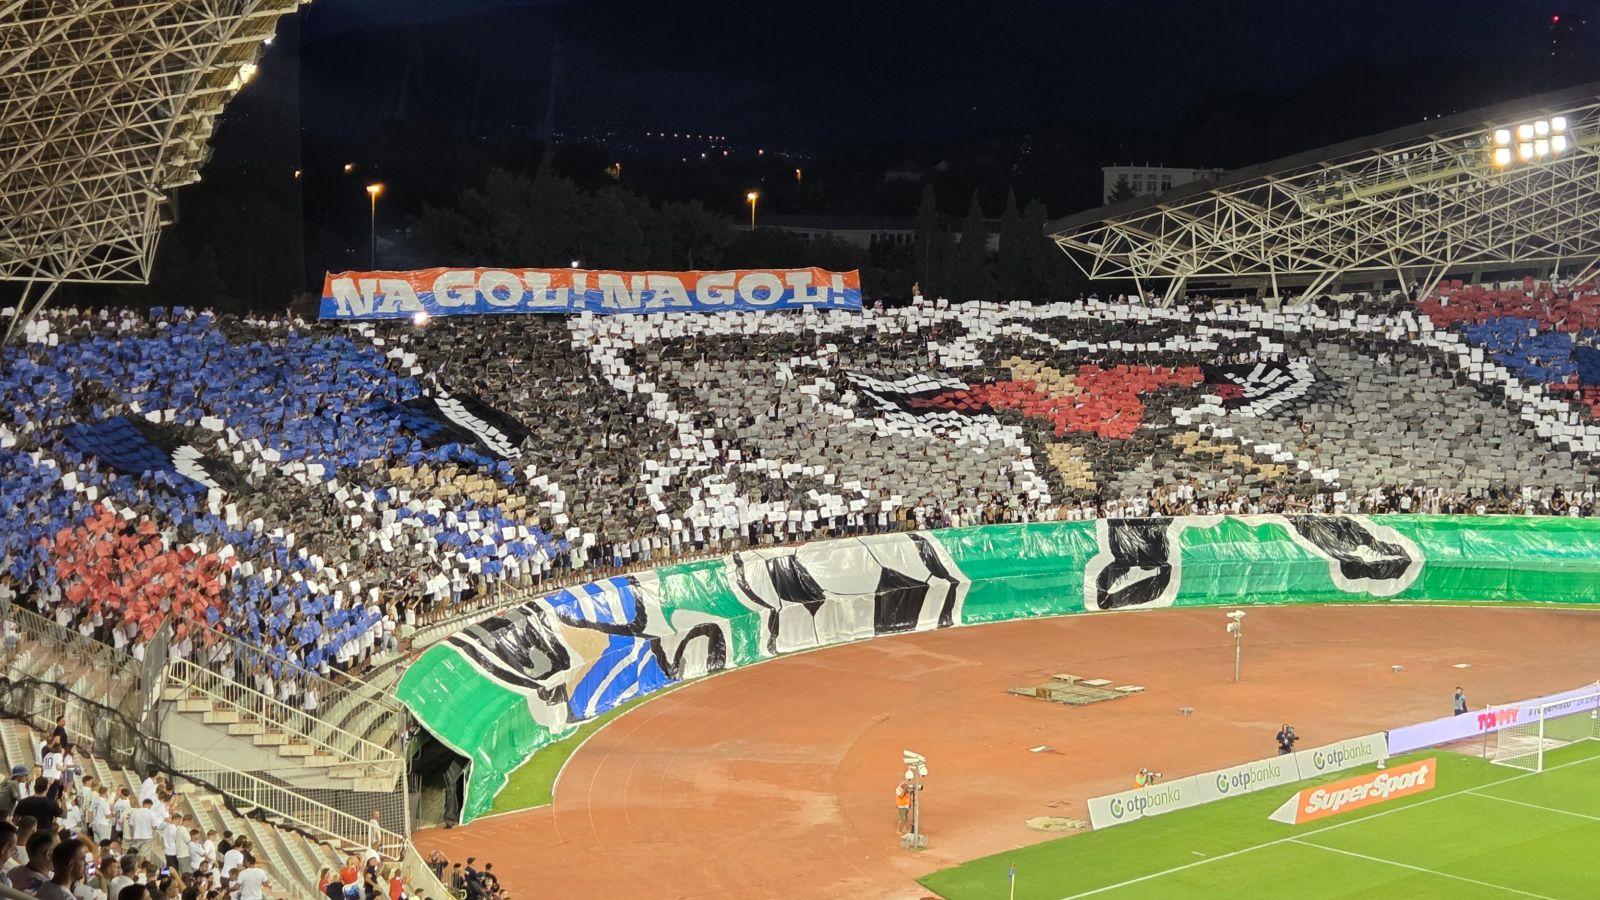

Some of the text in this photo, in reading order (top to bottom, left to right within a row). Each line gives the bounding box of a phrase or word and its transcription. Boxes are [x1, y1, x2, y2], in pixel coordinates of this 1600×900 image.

[331, 271, 845, 316] NA GOL! NA GOL!
[1478, 707, 1519, 730] TOMMY
[1305, 765, 1428, 814] SuperSport
